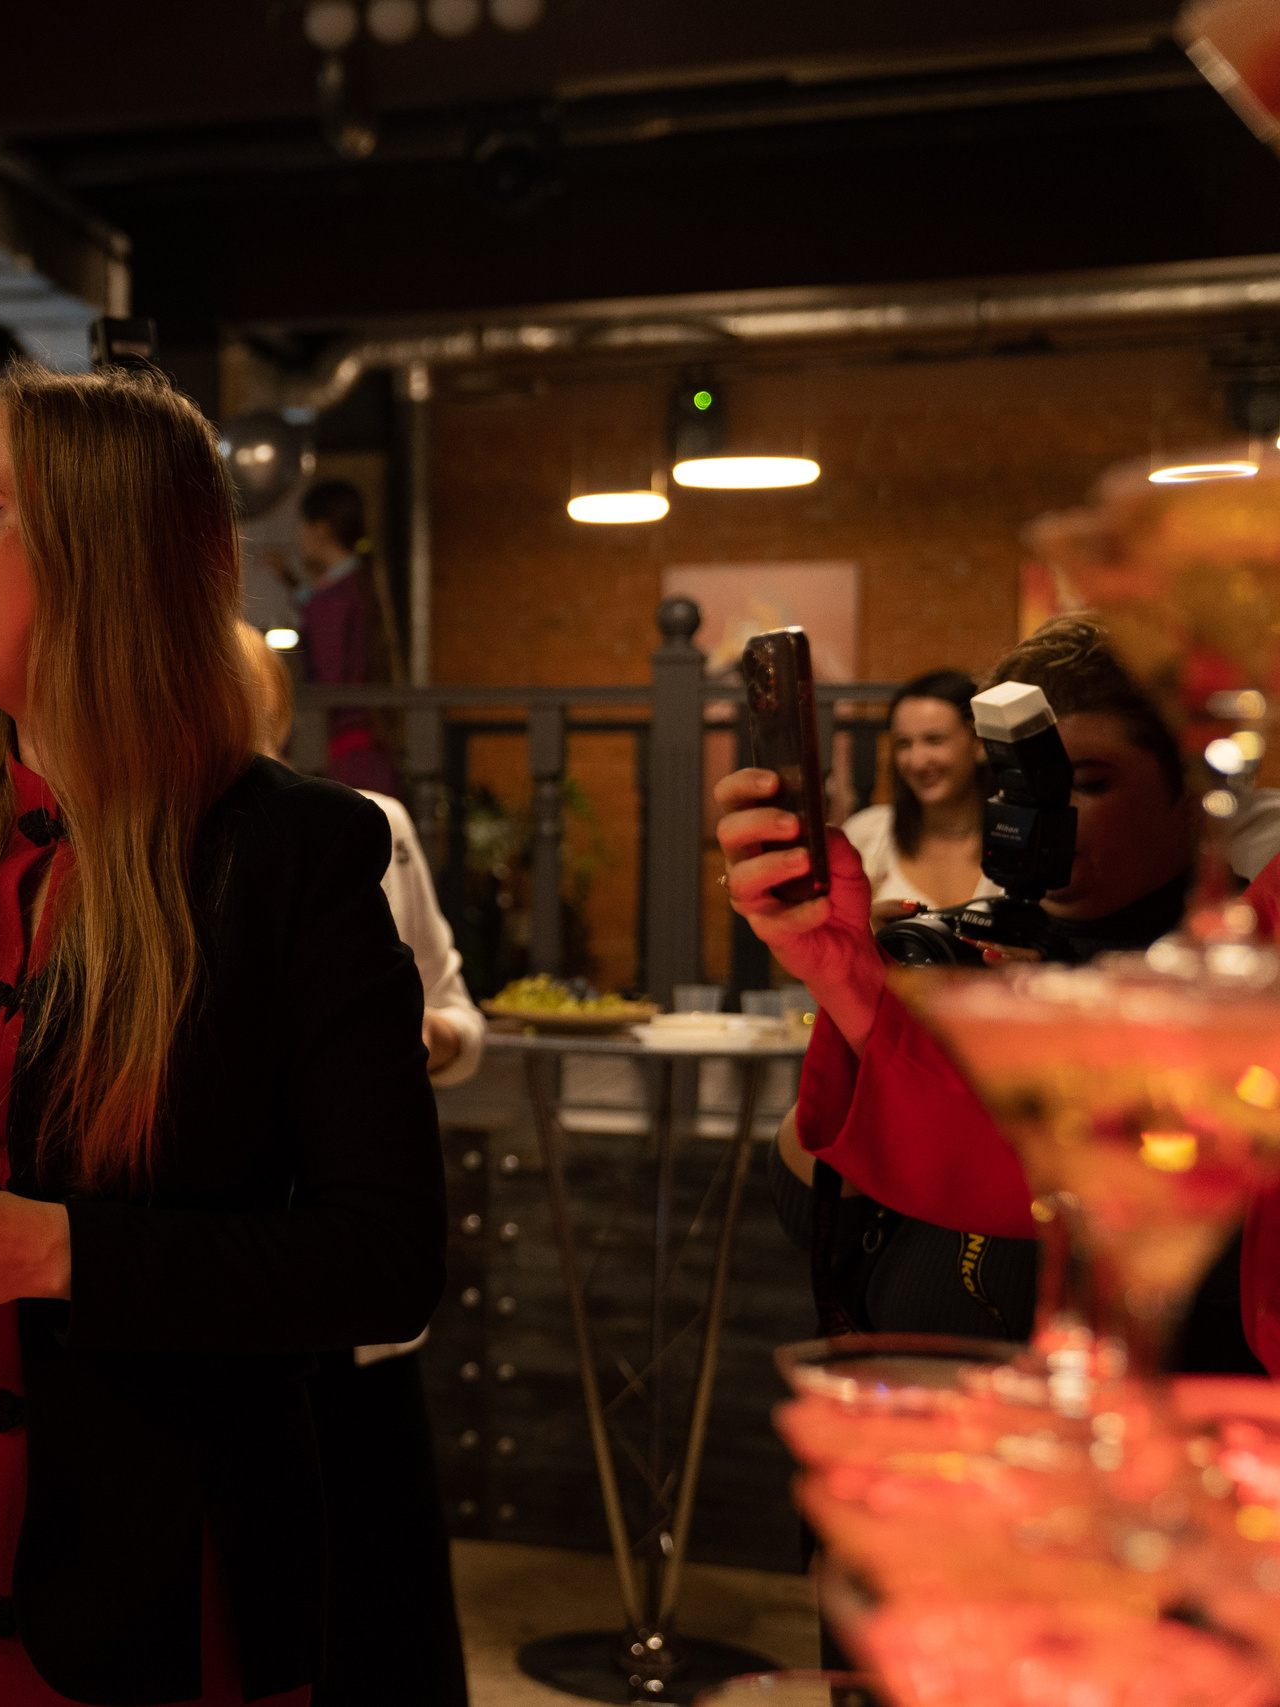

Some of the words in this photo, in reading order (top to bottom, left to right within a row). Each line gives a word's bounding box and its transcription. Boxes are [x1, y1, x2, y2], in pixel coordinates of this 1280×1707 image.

[995, 822, 1020, 834] Nikon
[960, 911, 992, 928] Nikon
[960, 1232, 986, 1293] Niko
